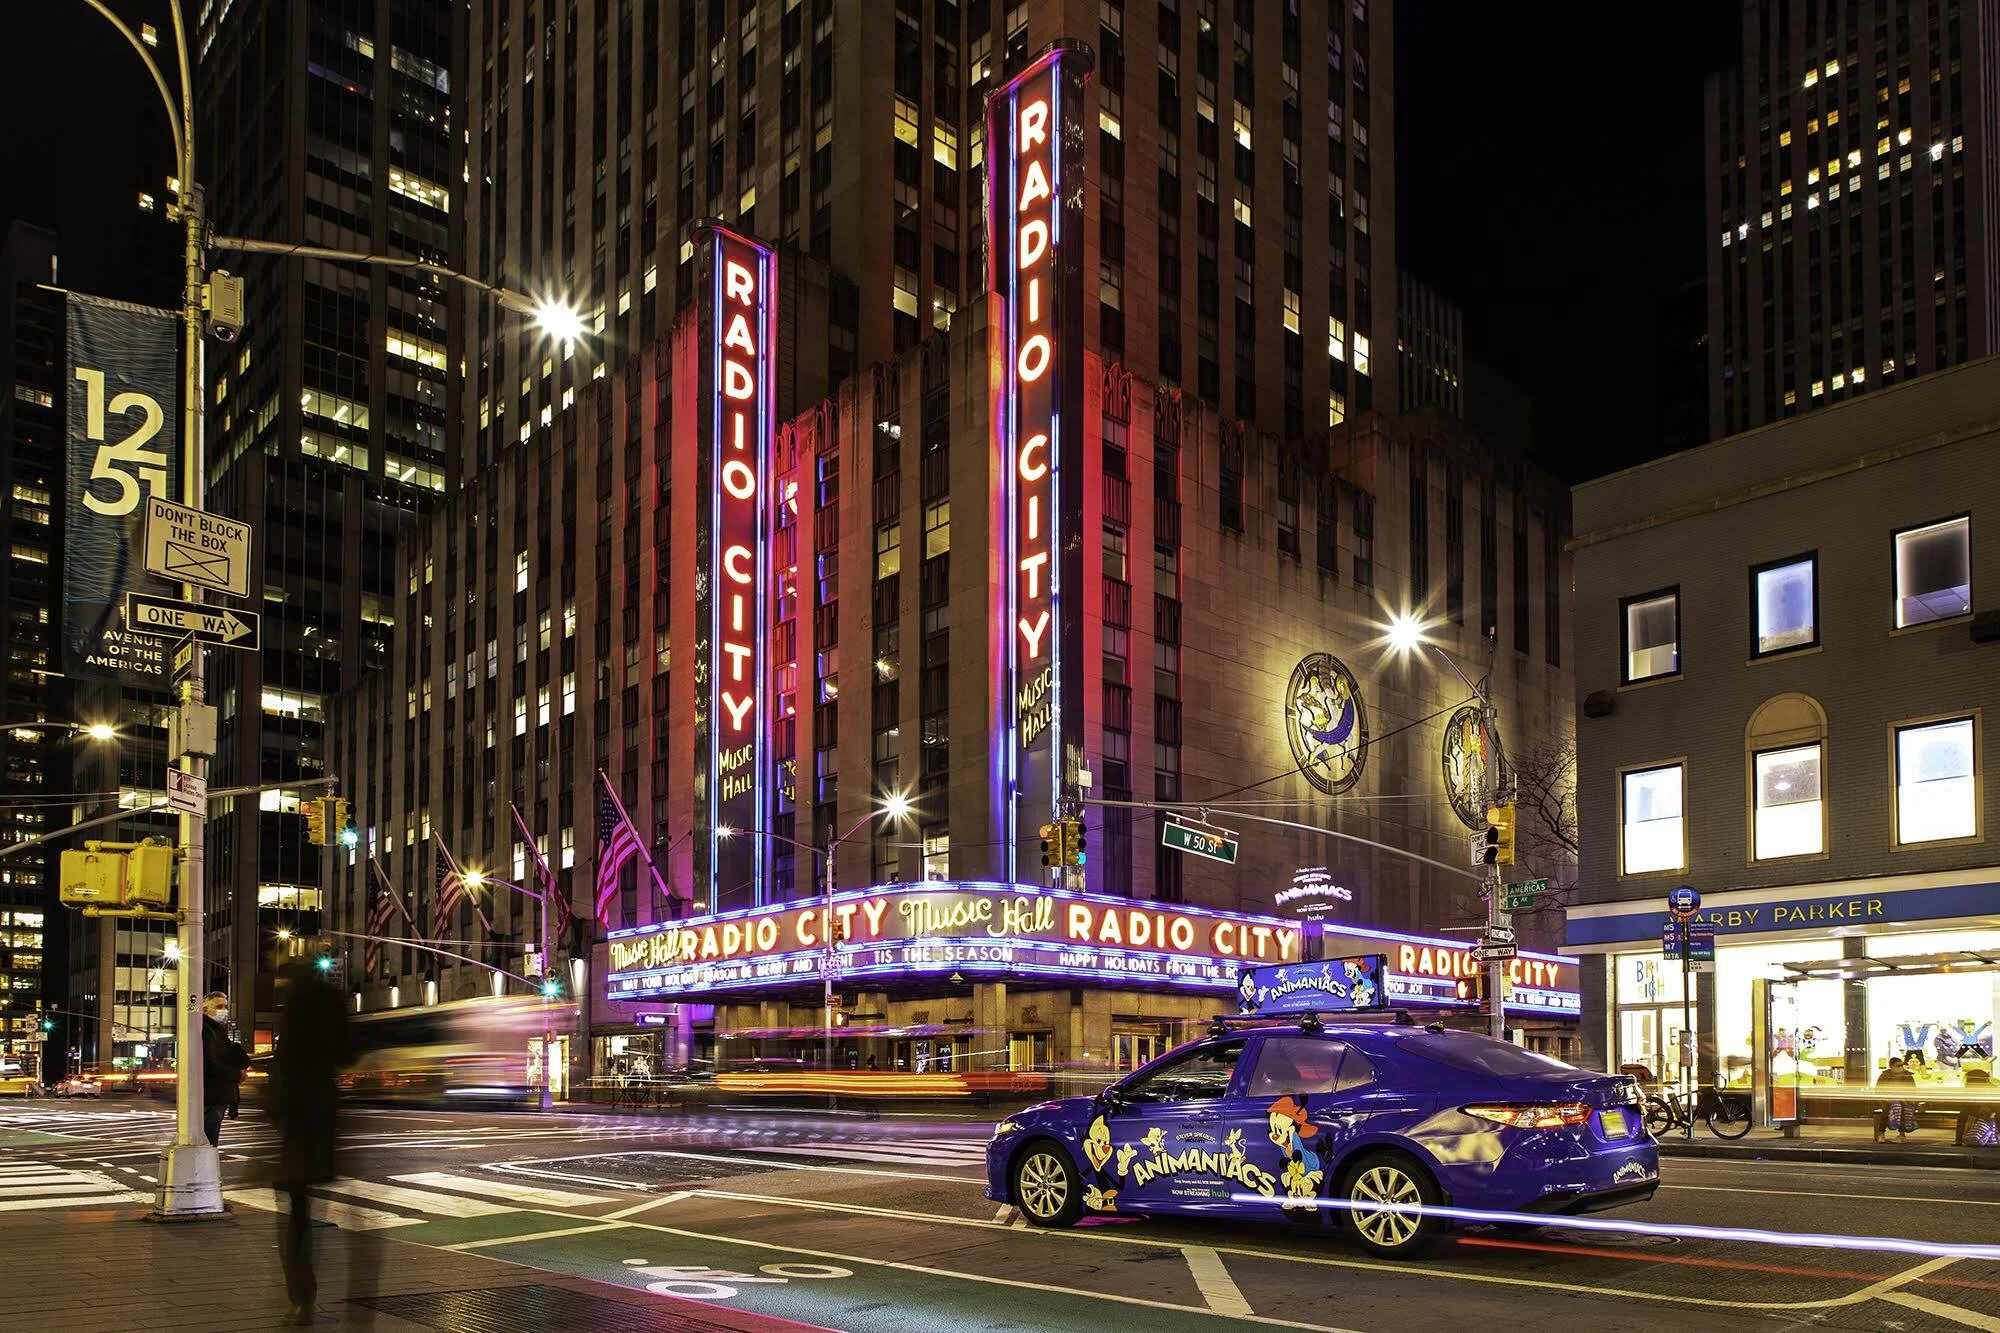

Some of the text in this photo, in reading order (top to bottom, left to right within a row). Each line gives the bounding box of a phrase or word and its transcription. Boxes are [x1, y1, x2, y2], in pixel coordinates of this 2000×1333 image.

[1018, 99, 1051, 659] RADIO CITY
[721, 260, 756, 731] RADIO CITY
[155, 504, 243, 542] DON'T BLOCK
[170, 525, 227, 553] THE BOX
[147, 607, 185, 627] ONE
[202, 616, 240, 635] WAY
[103, 630, 163, 648] AVENUE
[85, 654, 163, 675] AMERICAS
[108, 645, 163, 662] OF THE
[1018, 667, 1052, 719] MUSIC
[1022, 703, 1052, 748] HALL
[719, 744, 753, 776] MUSIC
[723, 773, 753, 802] HALL
[1184, 832, 1218, 854] W 50 St
[1274, 883, 1352, 906] ANIMANIACS
[1509, 883, 1546, 895] AMERICAS
[1512, 897, 1519, 907] 6
[899, 896, 1055, 937] Music Hall
[1663, 923, 1675, 931] M5
[1669, 909, 1759, 927] ARBY
[1774, 899, 1884, 923] PARKER
[682, 898, 887, 960] RADIO CITY
[1068, 904, 1297, 960] RADIO CITY
[1663, 933, 1675, 941] M5
[611, 928, 682, 971] Music Hall
[874, 946, 1013, 964] TIS THE SEASON
[1473, 948, 1513, 958] ONE WAY
[1664, 942, 1676, 951] M7
[622, 979, 638, 990] MAY
[642, 976, 662, 989] YOUR
[665, 972, 699, 986] HOLIDAY
[703, 968, 737, 981] SEASON
[793, 959, 813, 972] AND
[1059, 952, 1098, 968] HAPPY
[1104, 956, 1160, 973] HOLIDAYS
[1166, 962, 1196, 976] FROM
[1202, 964, 1220, 978] THE
[1400, 945, 1558, 988] RADIO CITY
[1270, 976, 1347, 1001] ANIMANIACS
[1389, 981, 1423, 995] YOU JOY
[1133, 1148, 1276, 1199] ANIMANIACS
[1211, 1189, 1230, 1198] hulu
